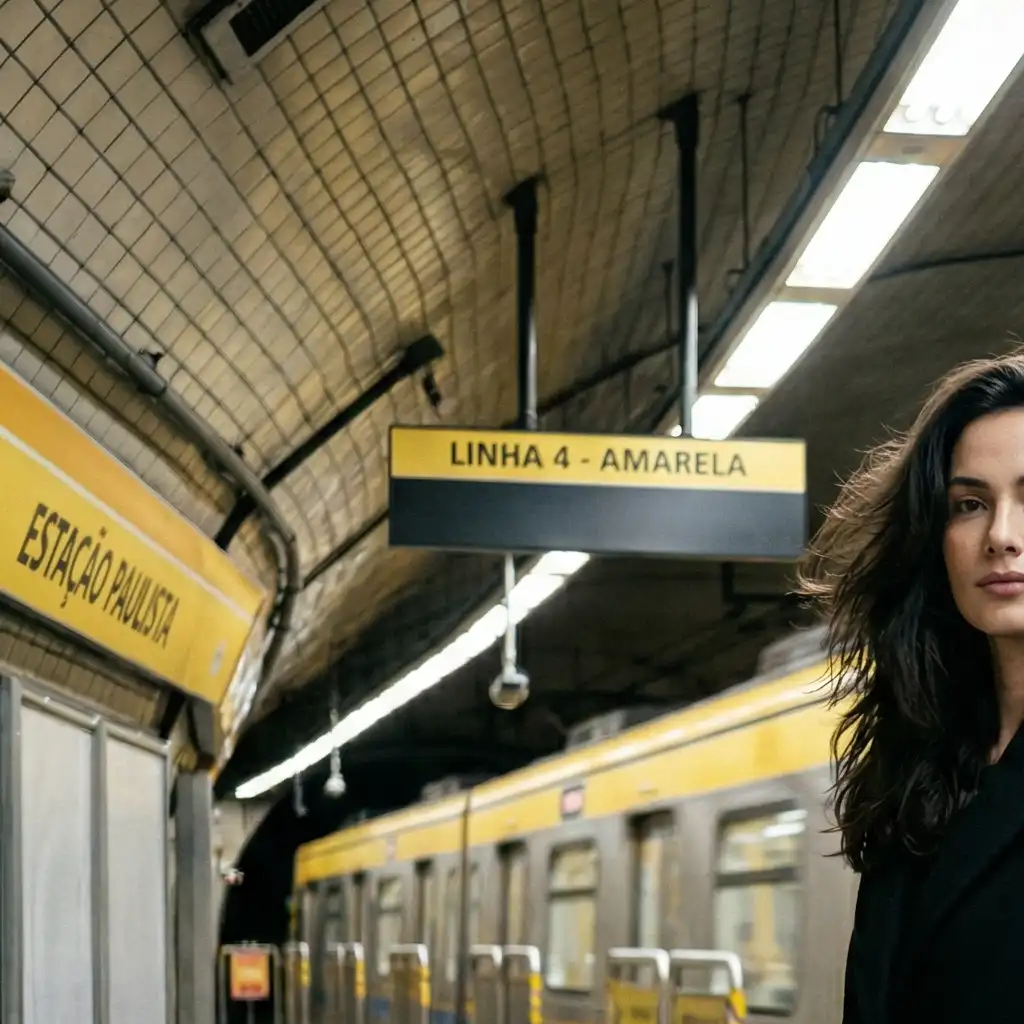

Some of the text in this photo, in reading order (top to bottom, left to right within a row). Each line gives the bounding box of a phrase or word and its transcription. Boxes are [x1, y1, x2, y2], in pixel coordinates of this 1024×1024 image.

[450, 441, 543, 469] LINHA
[553, 445, 570, 469] 4
[600, 448, 748, 477] AMARELA
[16, 502, 180, 649] ESTAÇÃO PAULISTA
